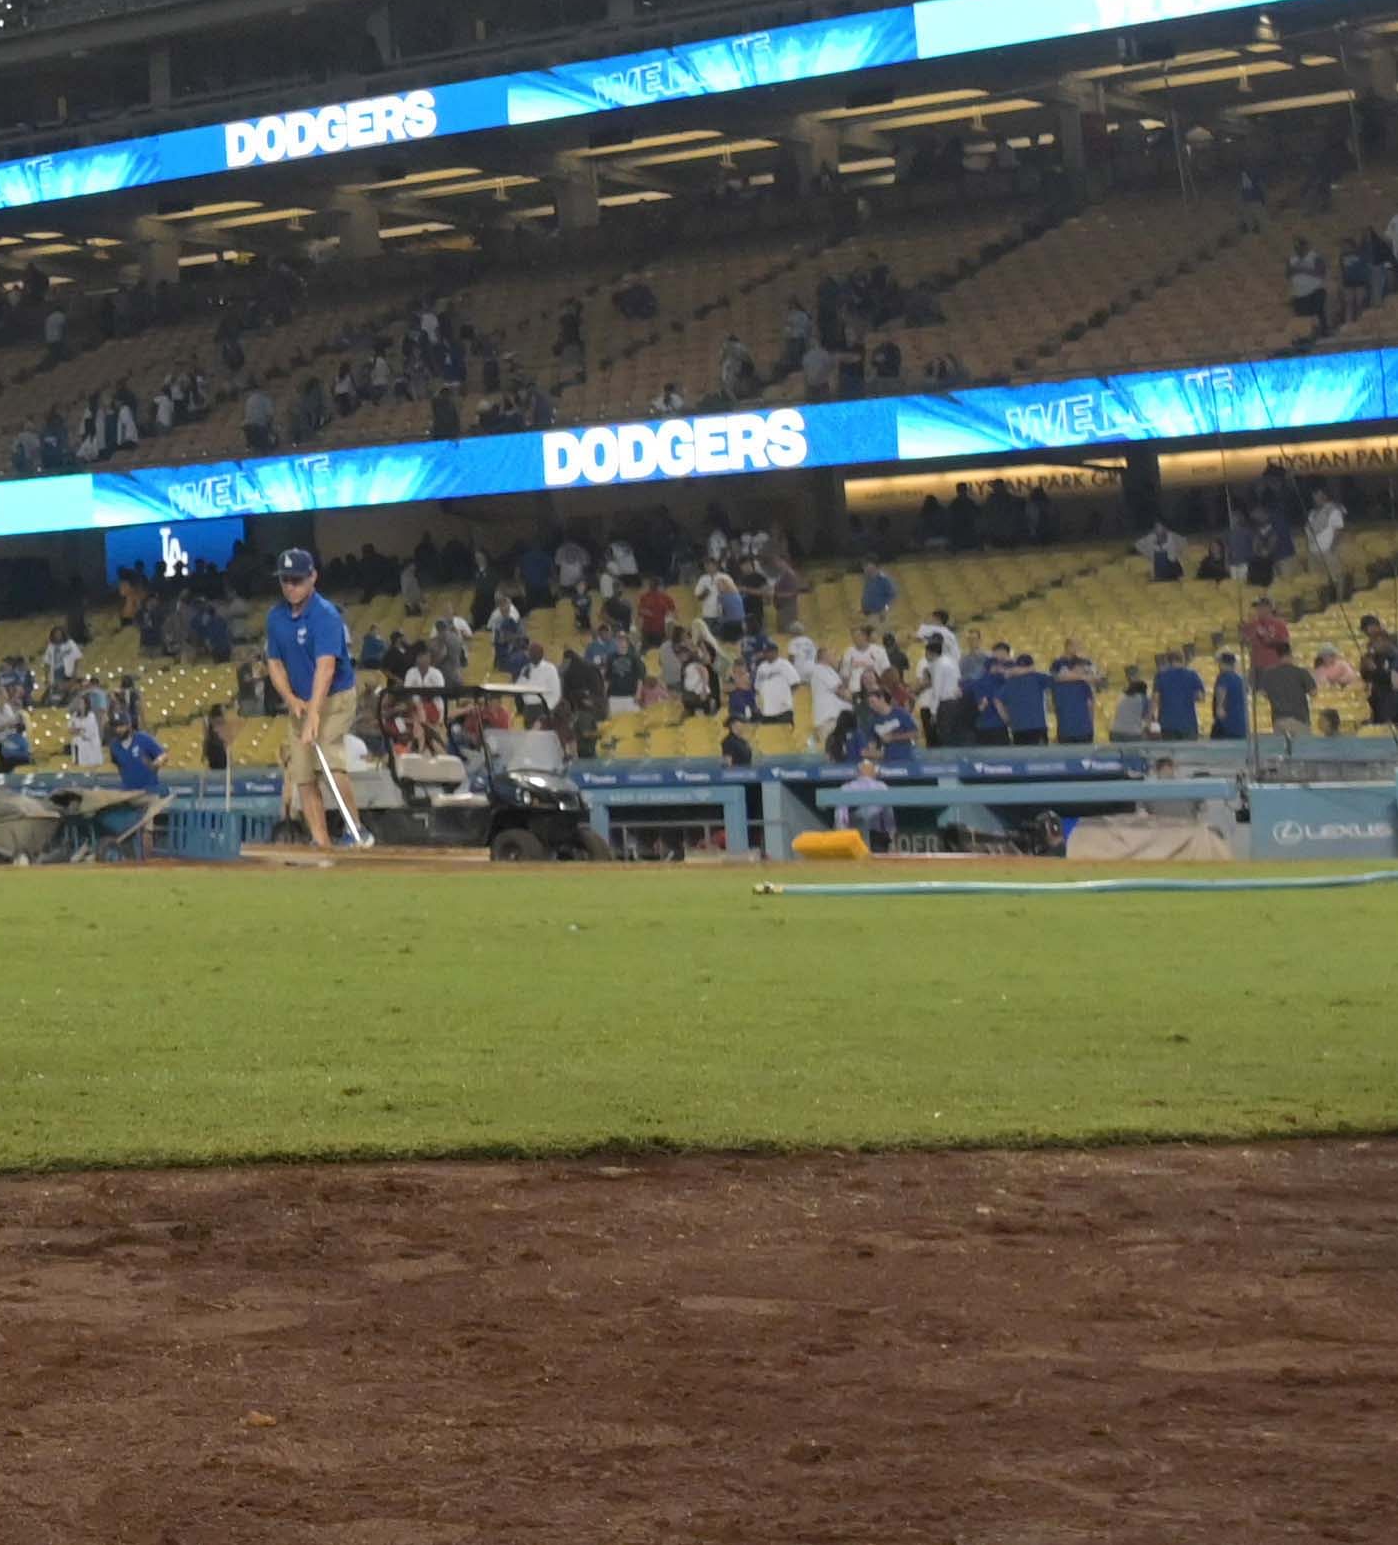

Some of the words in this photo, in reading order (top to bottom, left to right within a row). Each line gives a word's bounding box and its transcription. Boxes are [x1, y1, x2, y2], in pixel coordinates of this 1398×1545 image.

[223, 89, 437, 168] DODGERS
[542, 408, 808, 486] DODGERS
[1356, 445, 1398, 465] PAR
[1037, 469, 1085, 491] PARK
[159, 526, 189, 578] LA
